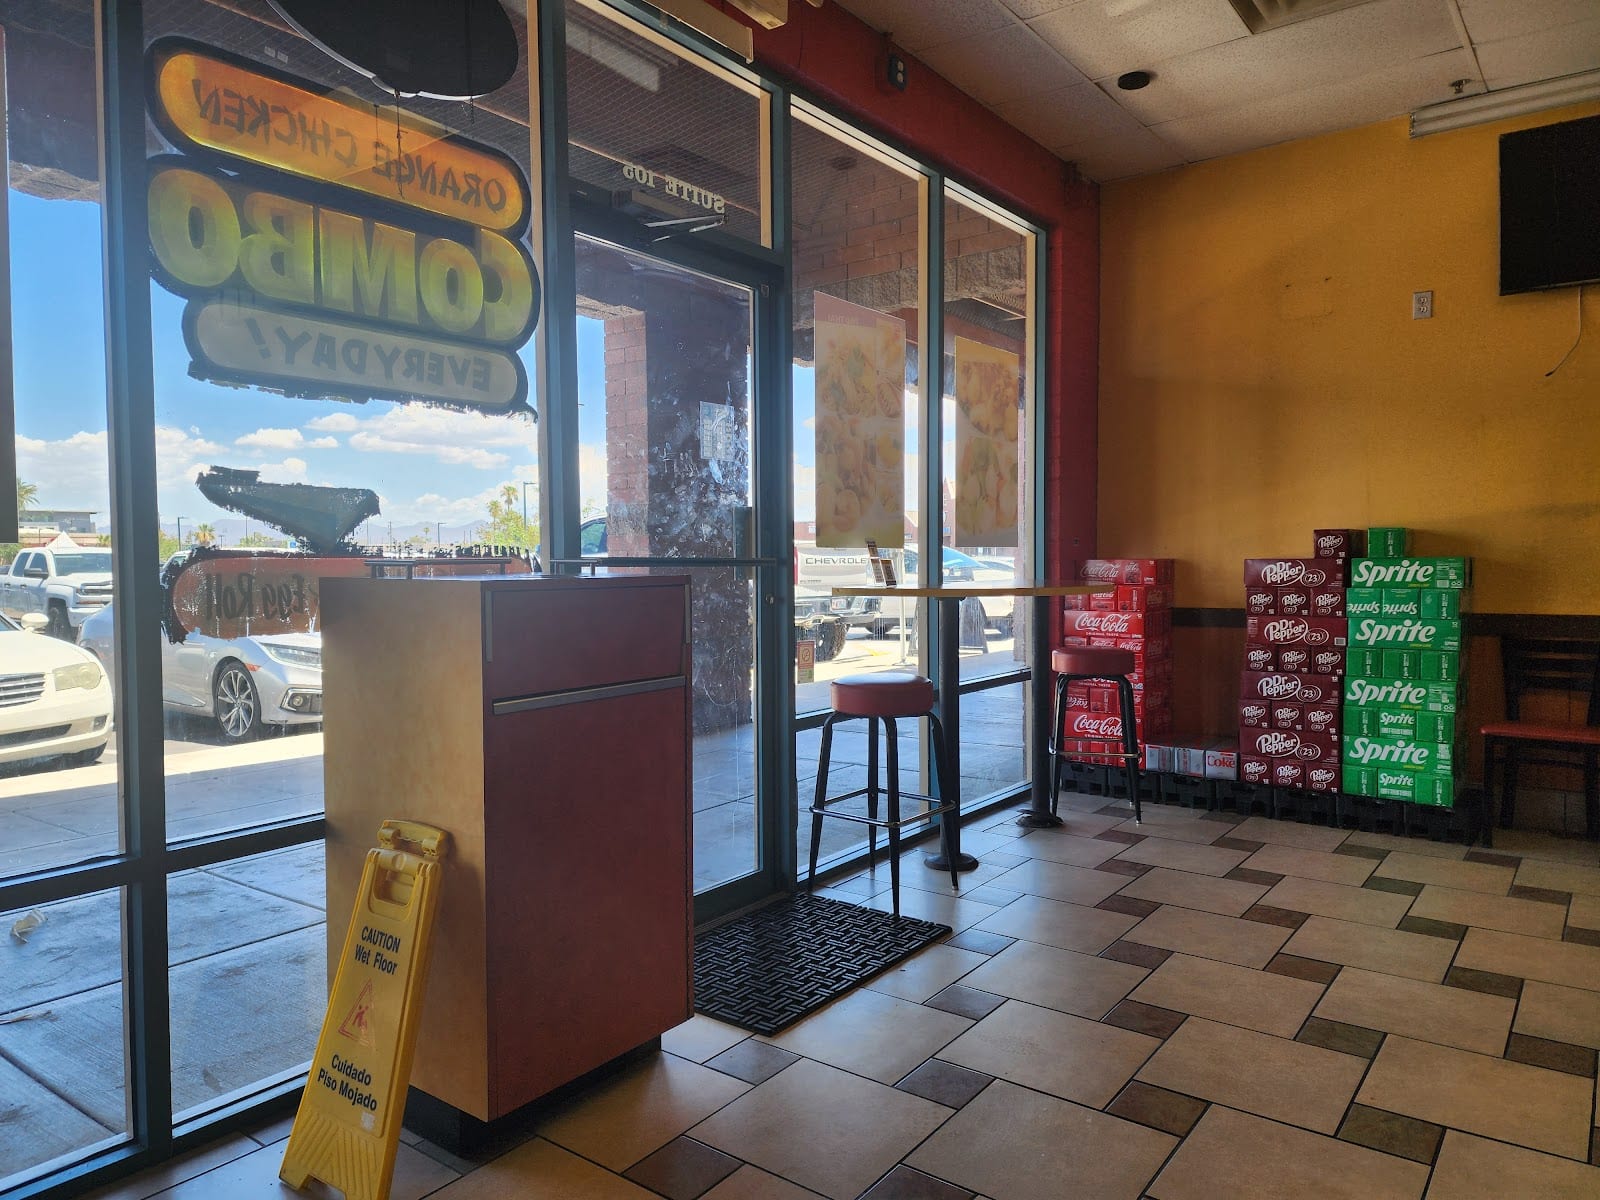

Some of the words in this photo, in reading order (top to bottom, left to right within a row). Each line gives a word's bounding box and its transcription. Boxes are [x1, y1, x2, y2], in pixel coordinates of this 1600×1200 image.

[1319, 537, 1341, 548] Pepper
[805, 557, 869, 565] CHEVROLE
[1276, 561, 1292, 571] Dr
[1266, 564, 1302, 585] Pepper
[1353, 560, 1434, 587] Sprite
[1252, 596, 1270, 605] Pepper
[1284, 596, 1304, 606] Pepper
[1318, 596, 1339, 606] Pepper
[1346, 601, 1380, 614] Sprite
[1384, 602, 1418, 614] Sprite
[1074, 612, 1132, 633] Coca-Cola
[1279, 620, 1295, 630] Dr
[1269, 622, 1305, 641] Pepper
[1355, 619, 1436, 646] Sprite
[1250, 652, 1270, 662] Pepper
[1284, 652, 1304, 662] Pepper
[1318, 654, 1339, 664] Pepper
[1272, 675, 1288, 684] Dr
[1262, 678, 1298, 697] Pepper
[1346, 680, 1426, 706] Sprite
[1244, 707, 1264, 718] Pepper
[1278, 710, 1297, 720] Pepper
[1310, 712, 1330, 722] Pepper
[1380, 712, 1414, 725] Sprite
[1074, 714, 1123, 736] Coca-Cola
[1271, 732, 1286, 742] Dr
[1260, 735, 1296, 754] Pepper
[1349, 738, 1429, 764] Sprite
[1207, 754, 1236, 769] Coke
[1246, 763, 1264, 773] Pepper
[1278, 767, 1298, 776] Pepper
[1312, 771, 1332, 781] Pepper
[1380, 773, 1414, 786] Sprite
[361, 926, 401, 953] CAUTION
[355, 944, 371, 965] Wet
[373, 951, 398, 975] Floor
[331, 1054, 371, 1086] Cuidado
[318, 1067, 337, 1091] Piso
[338, 1080, 377, 1111] Mojado
